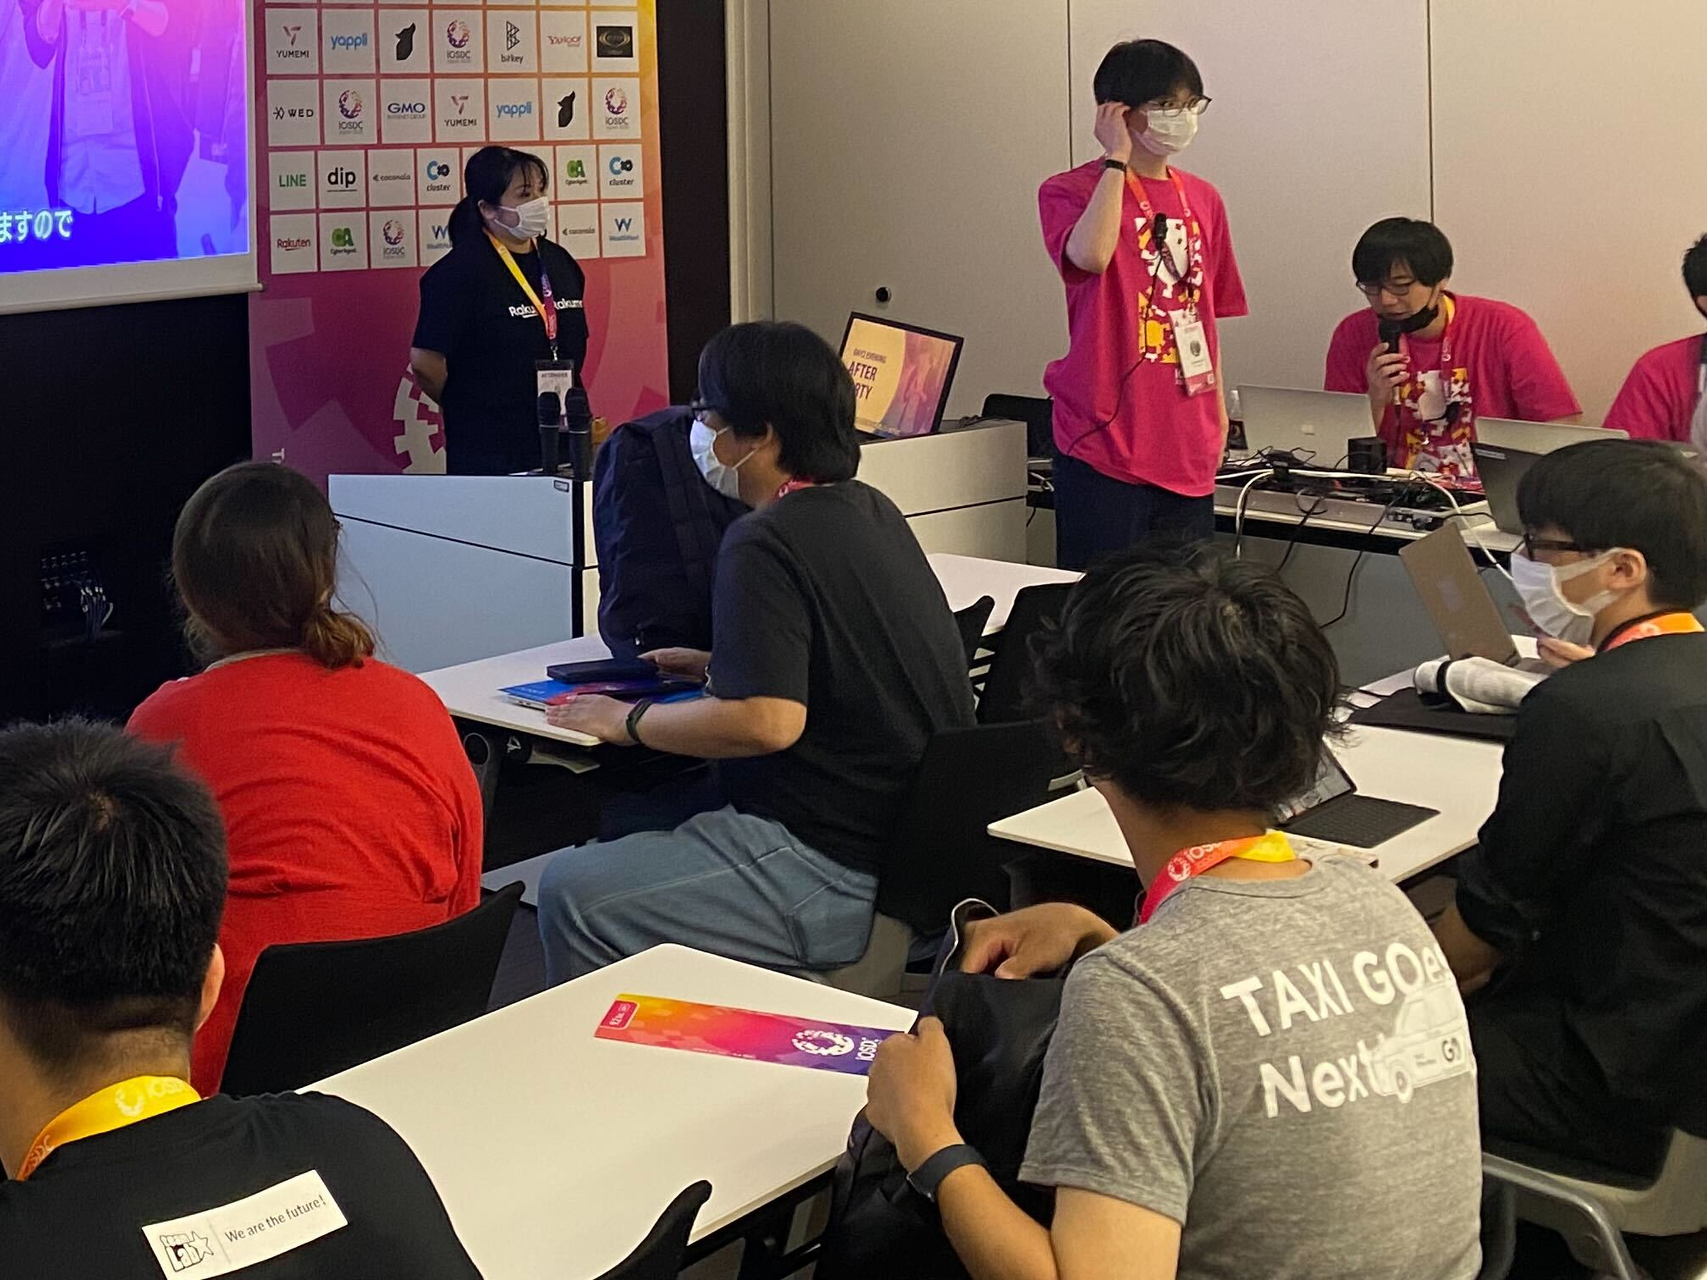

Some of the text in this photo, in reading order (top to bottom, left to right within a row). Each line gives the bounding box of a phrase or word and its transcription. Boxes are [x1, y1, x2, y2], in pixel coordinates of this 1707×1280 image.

[330, 33, 368, 50] yappli
[276, 50, 309, 58] YUMEMI
[501, 53, 524, 64] bitkey
[288, 109, 314, 117] WED
[387, 102, 426, 114] GMO
[496, 101, 532, 118] yappli
[444, 118, 477, 127] YUMEMI
[279, 174, 306, 187] LINE
[327, 167, 356, 188] dip
[609, 178, 635, 187] cluster
[426, 183, 450, 191] cluster
[277, 238, 311, 251] Rakuten
[848, 361, 877, 381] AFTER
[854, 382, 873, 400] RTY
[1220, 960, 1355, 1036] TAXI
[224, 1229, 246, 1243] We
[247, 1223, 266, 1236] are
[266, 1214, 286, 1228] the
